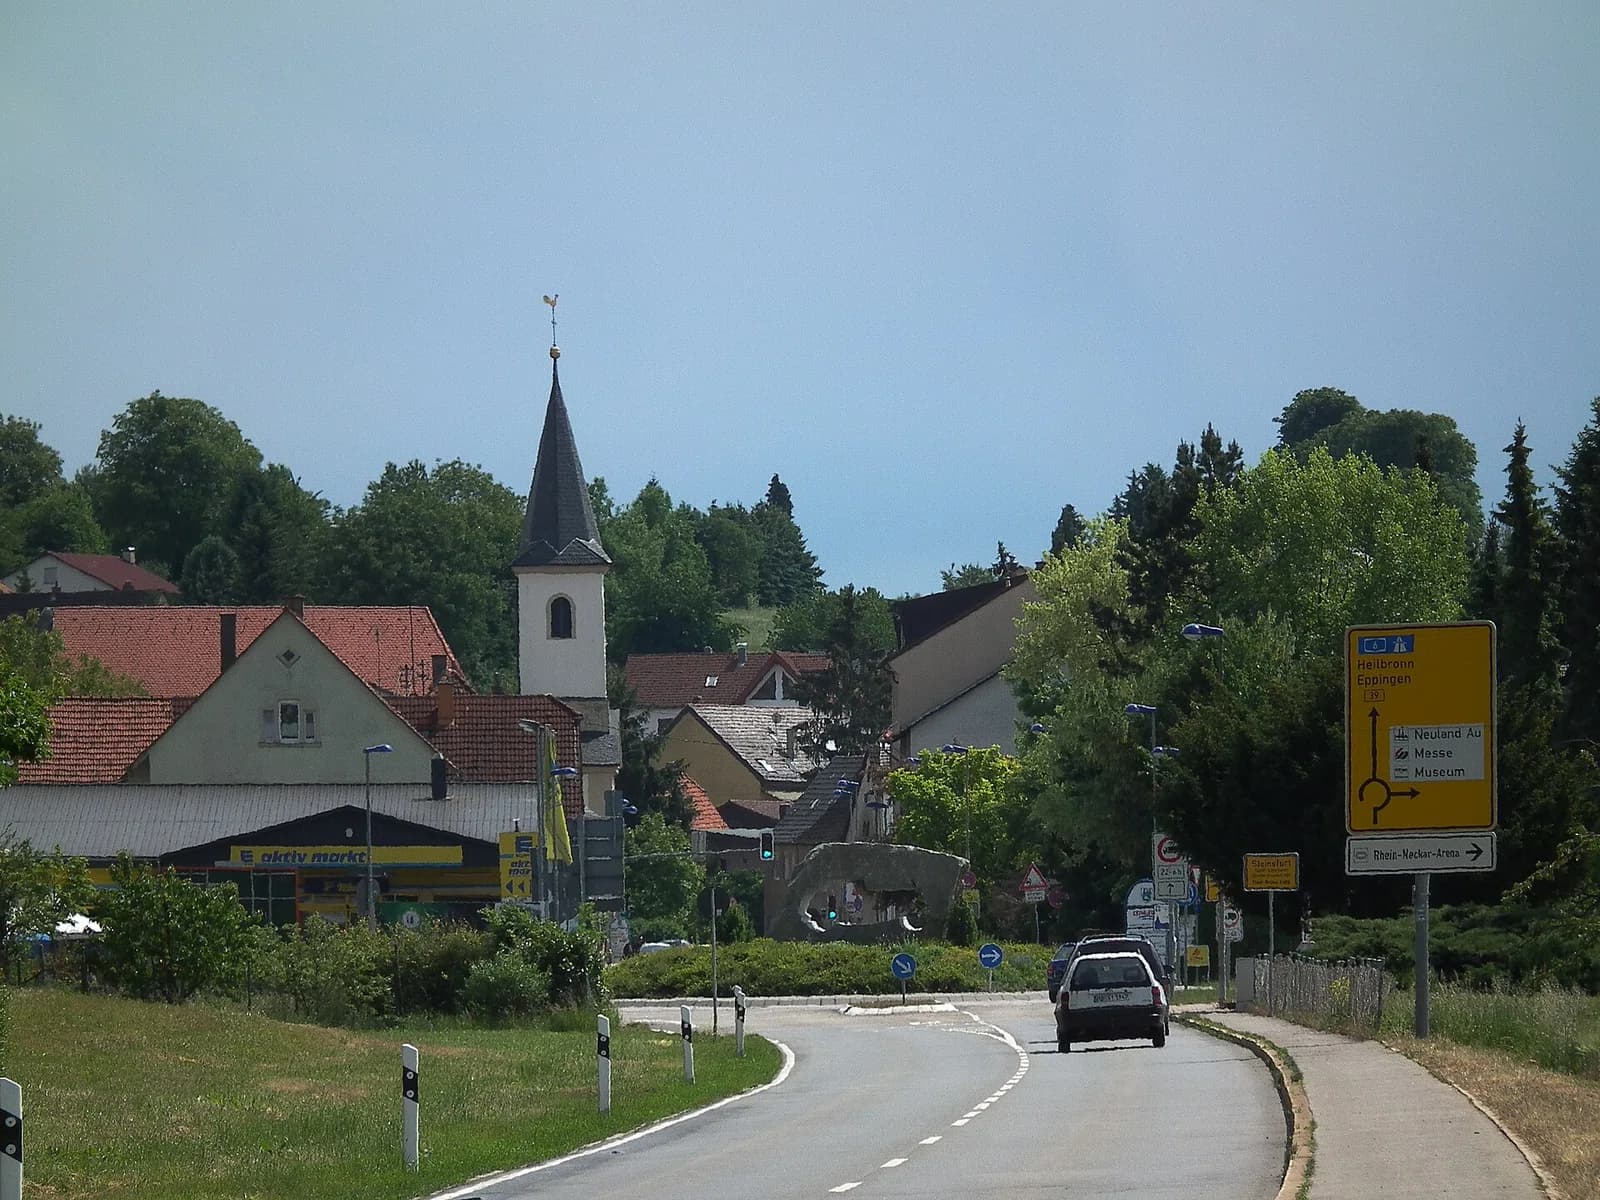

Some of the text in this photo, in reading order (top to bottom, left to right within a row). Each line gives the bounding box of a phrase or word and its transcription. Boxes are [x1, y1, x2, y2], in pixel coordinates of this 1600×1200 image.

[1357, 659, 1414, 670] Heilbronn
[1357, 673, 1411, 687] Eppingen
[1369, 691, 1379, 700] 39
[1414, 728, 1481, 740] Neuland Au
[1414, 748, 1453, 759] Messe
[1414, 767, 1465, 778] Museum
[261, 850, 307, 863] aktiv
[312, 850, 366, 863] markt
[1373, 848, 1461, 861] Rhein-Neckar-Arena
